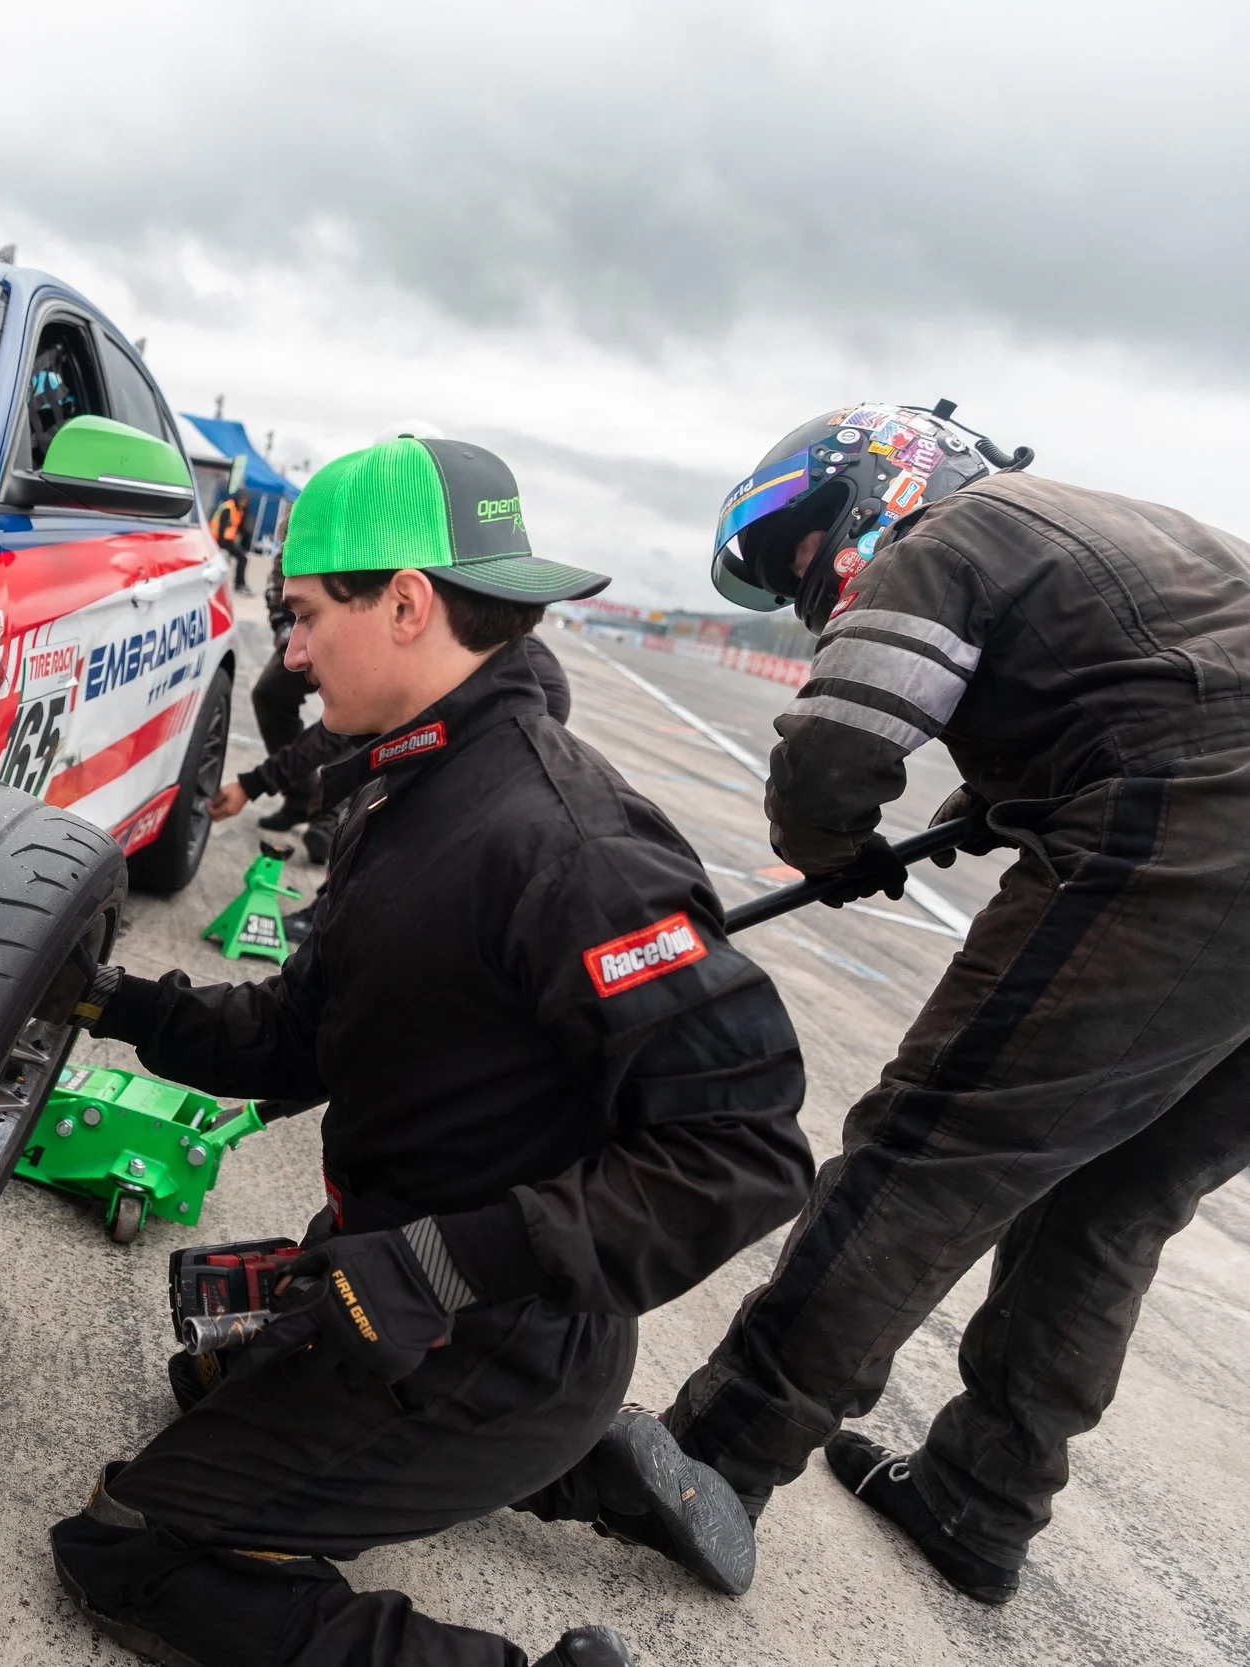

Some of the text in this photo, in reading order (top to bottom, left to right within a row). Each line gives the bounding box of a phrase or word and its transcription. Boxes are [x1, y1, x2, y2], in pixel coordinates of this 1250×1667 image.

[884, 510, 899, 520] 023
[29, 645, 76, 681] TIRE RACK
[600, 925, 695, 983] RaceQuip
[332, 1269, 378, 1342] FIRM GRIP
